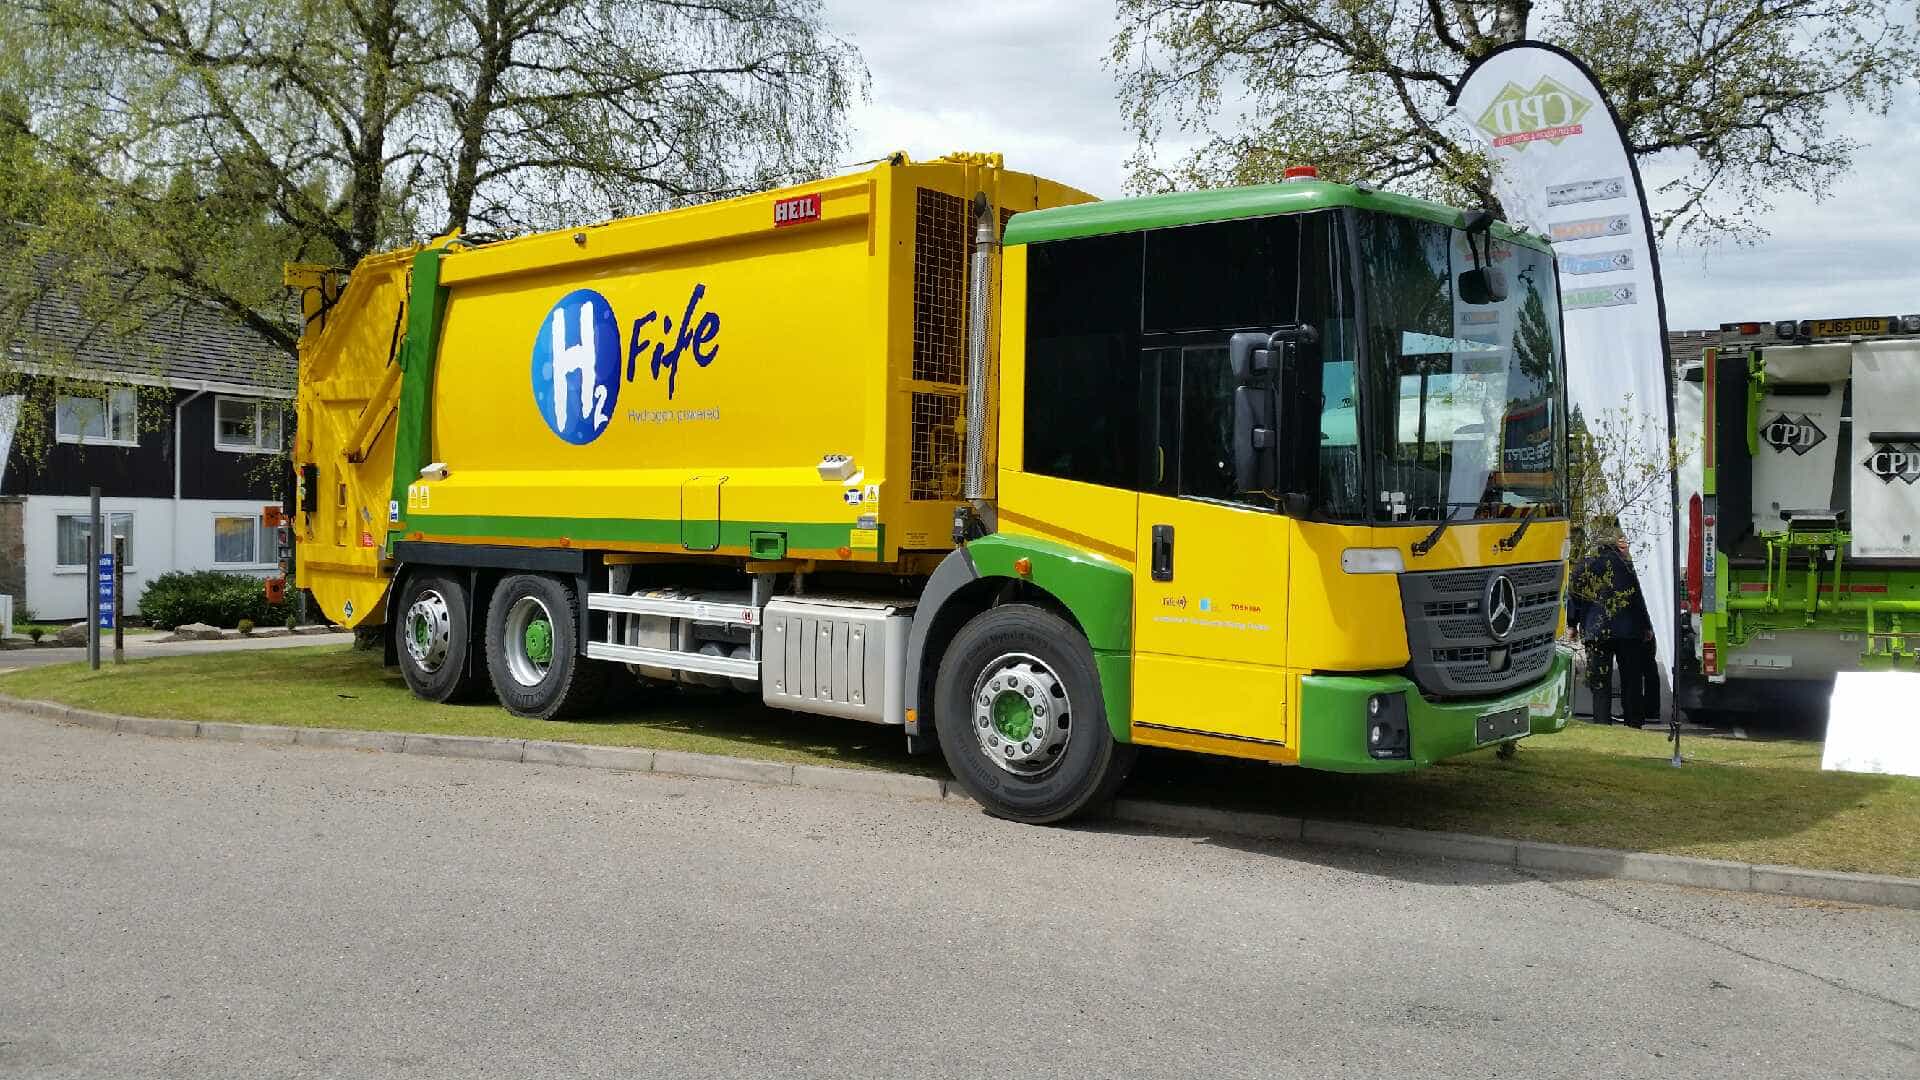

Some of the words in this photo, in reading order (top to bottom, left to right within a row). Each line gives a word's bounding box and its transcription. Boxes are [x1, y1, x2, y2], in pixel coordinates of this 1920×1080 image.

[775, 199, 817, 222] HEIL
[626, 283, 721, 401] Fife
[627, 407, 674, 424] Hydrogen
[677, 405, 720, 423] powered
[1766, 423, 1815, 446] CPD
[1871, 452, 1920, 475] CPD
